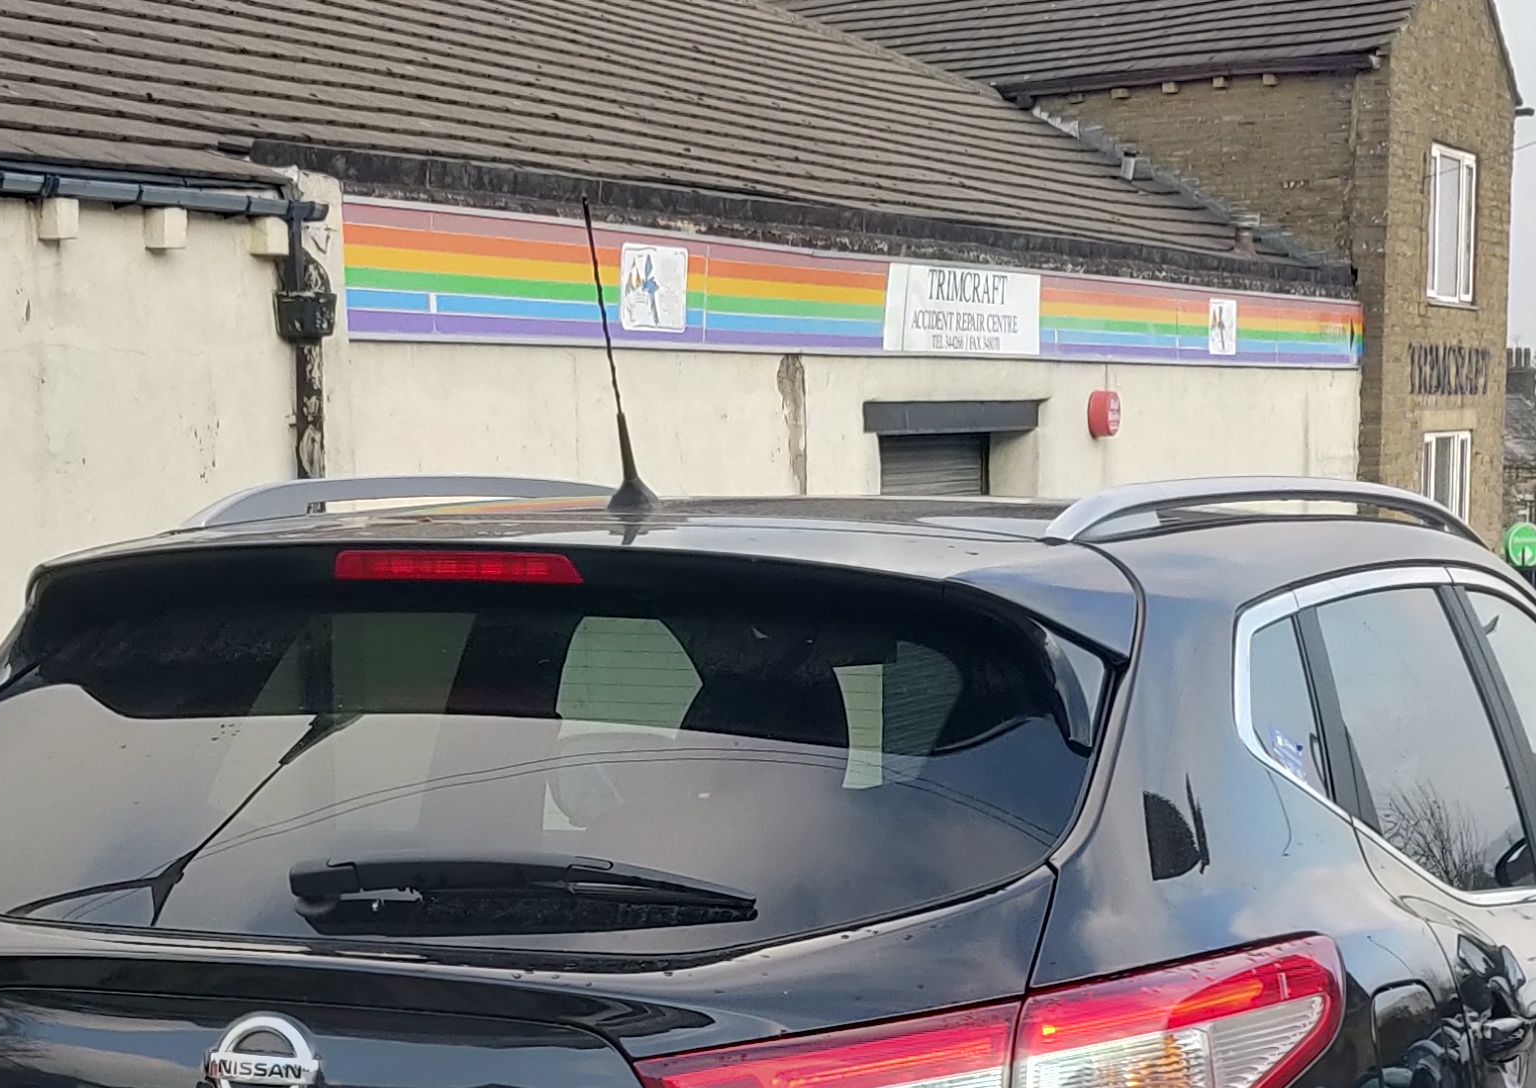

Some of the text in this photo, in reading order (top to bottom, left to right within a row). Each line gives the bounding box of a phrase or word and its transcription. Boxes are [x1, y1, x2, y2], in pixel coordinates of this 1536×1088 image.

[928, 269, 1007, 305] TRIMCRAFT
[911, 310, 1018, 334] ACCIDENT REPAIR CENTRE
[970, 336, 981, 350] FAX
[1408, 342, 1490, 395] TRIMCRAFT
[218, 1059, 302, 1079] NISSAN
